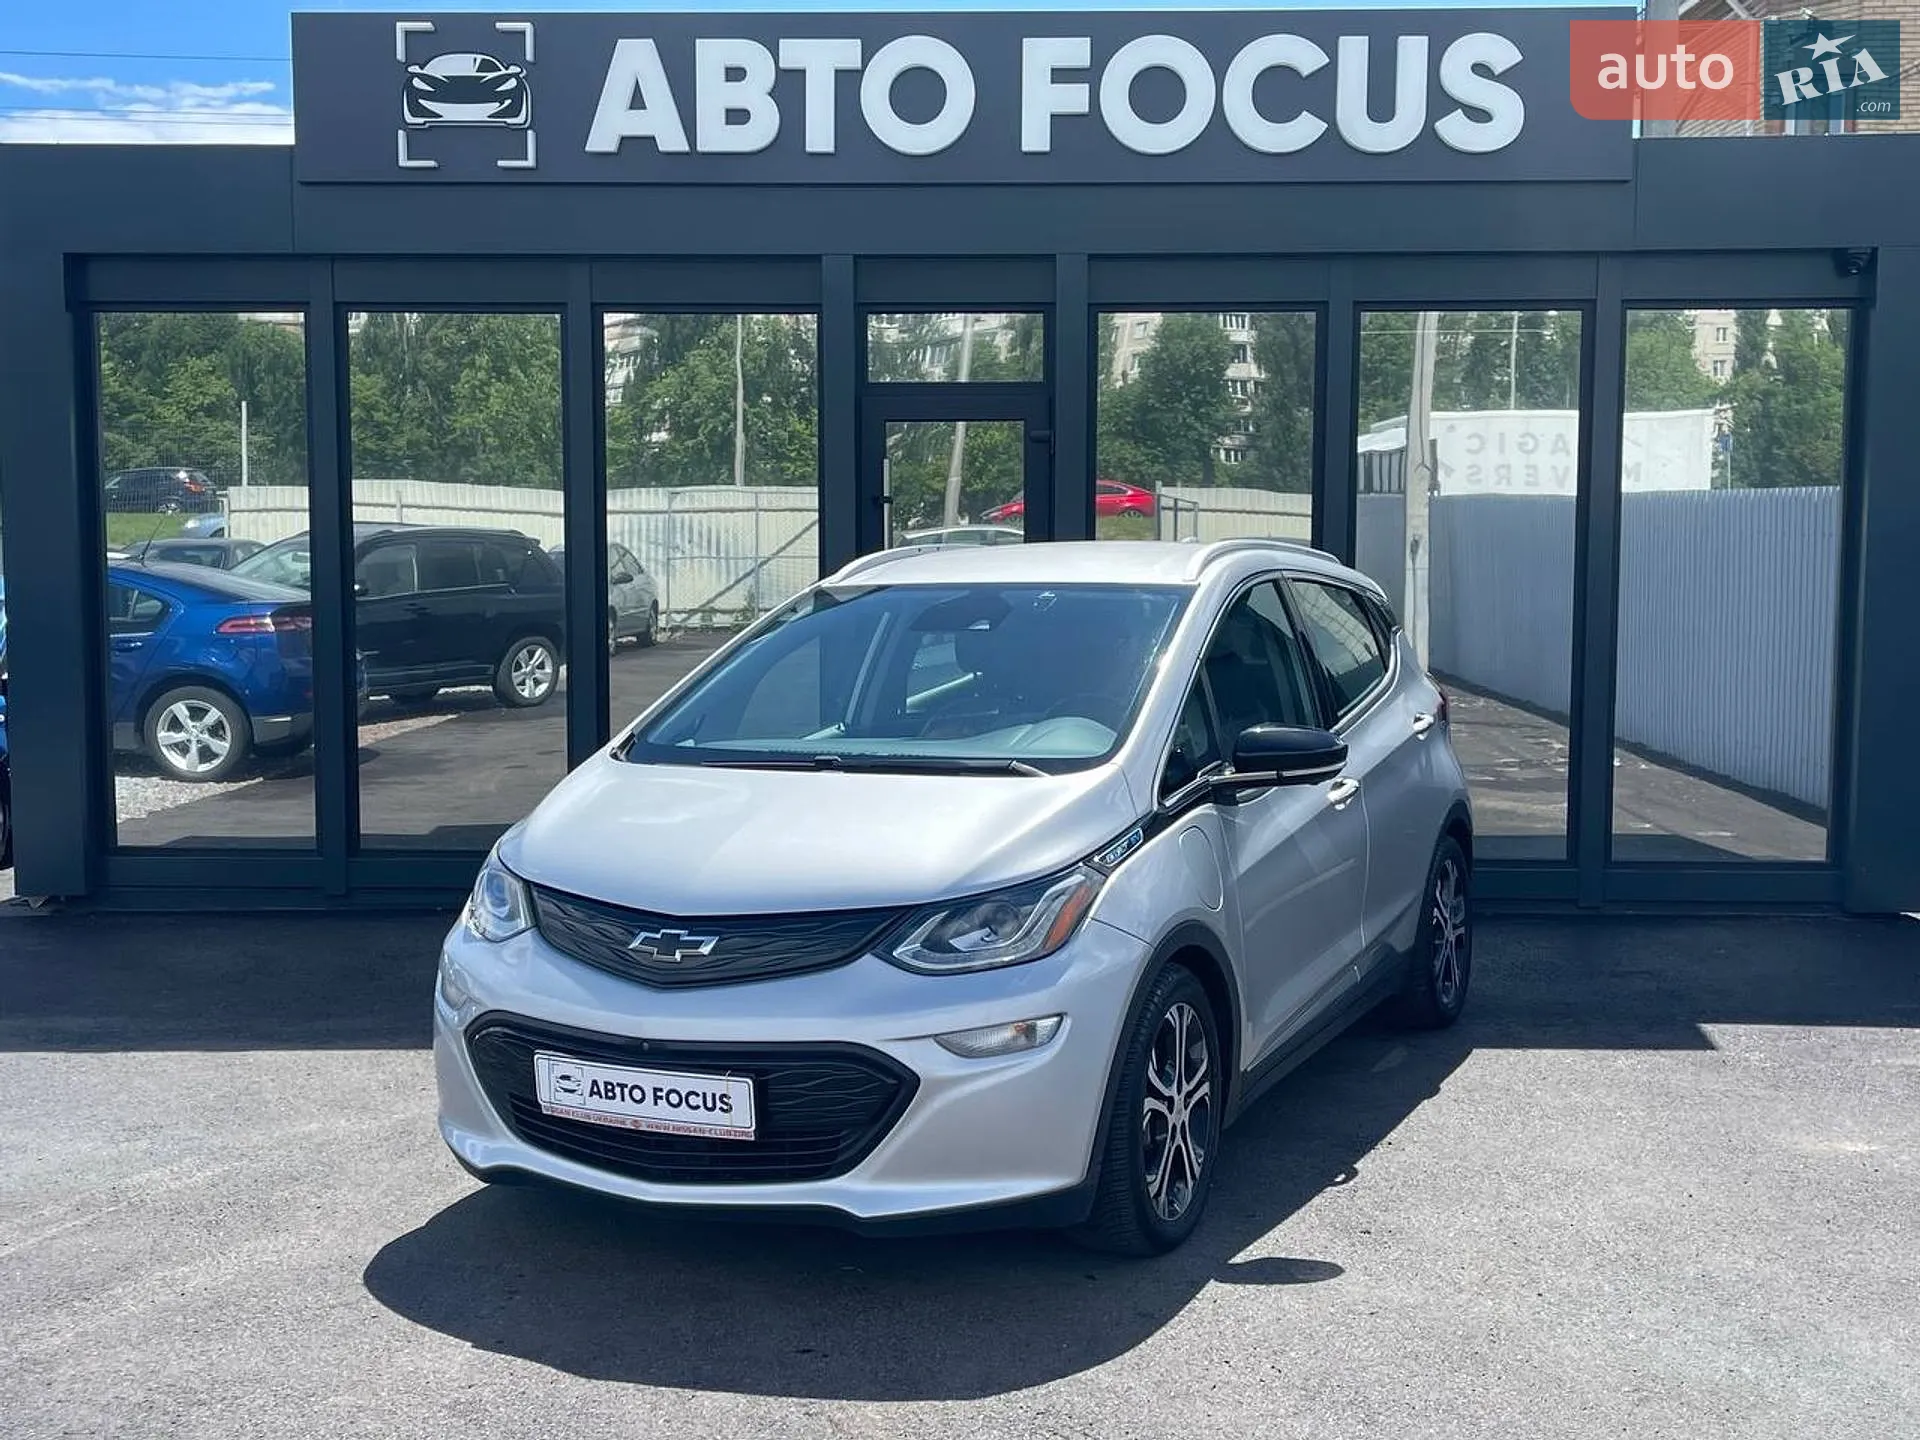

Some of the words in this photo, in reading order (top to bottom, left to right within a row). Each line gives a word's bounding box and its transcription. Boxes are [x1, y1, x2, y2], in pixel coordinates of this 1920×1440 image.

[584, 35, 976, 156] АВТО
[1020, 33, 1525, 156] FOCUS
[588, 1078, 646, 1105] АВТО
[652, 1087, 734, 1114] FOCUS
